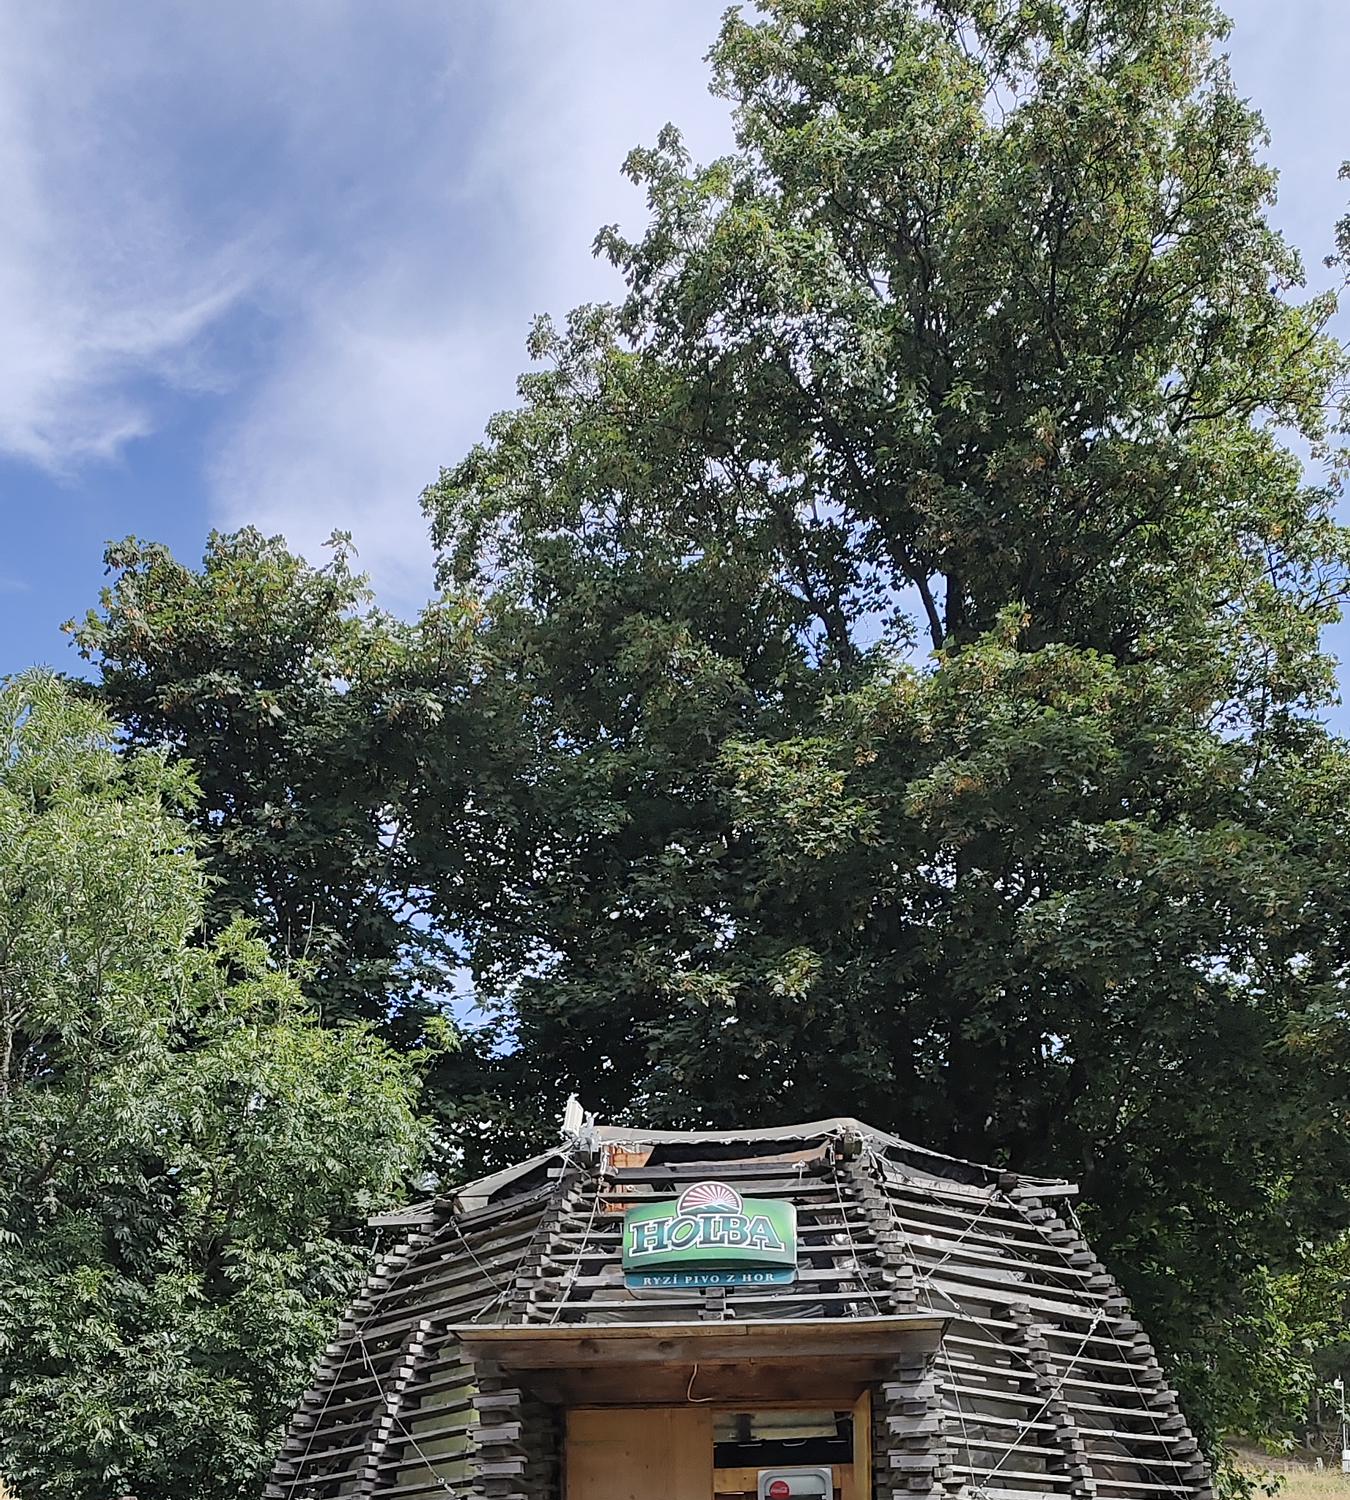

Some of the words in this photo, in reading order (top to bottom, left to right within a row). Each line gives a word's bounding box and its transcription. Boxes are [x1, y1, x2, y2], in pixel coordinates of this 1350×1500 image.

[629, 1214, 785, 1257] HOLBA
[643, 1274, 678, 1286] RYZÍ
[685, 1275, 720, 1284] PIVO
[726, 1274, 736, 1283] Z
[742, 1273, 775, 1282] HOR
